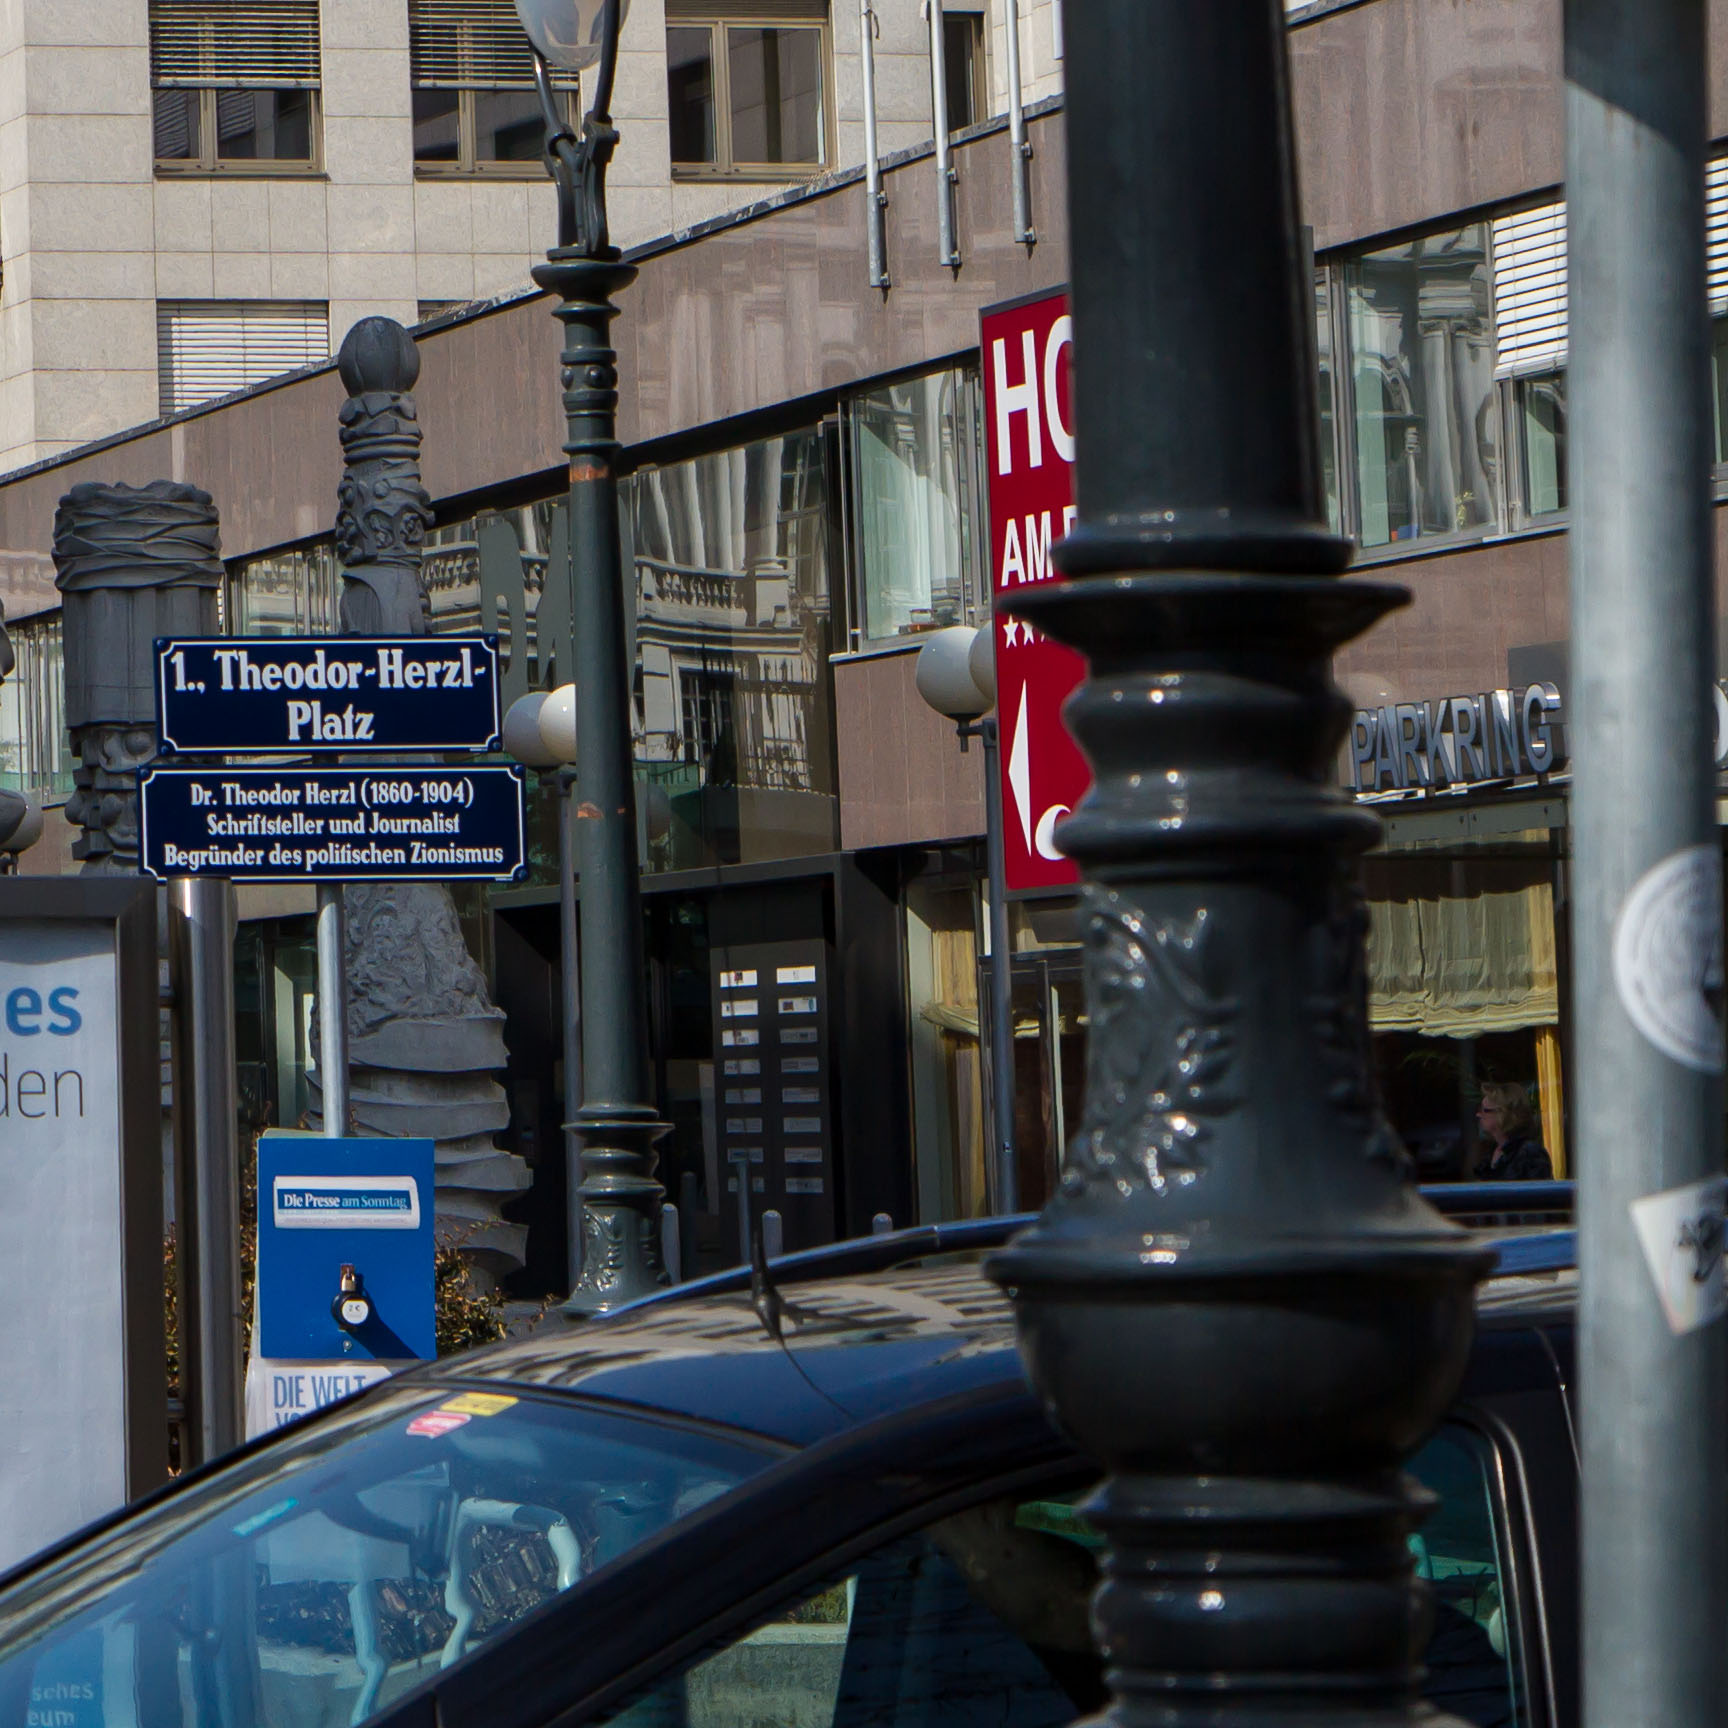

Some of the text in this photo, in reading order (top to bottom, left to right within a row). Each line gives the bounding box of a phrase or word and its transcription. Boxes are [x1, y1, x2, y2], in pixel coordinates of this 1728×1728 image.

[1001, 511, 1054, 587] AM
[214, 649, 486, 690] Theodor-Herzl-
[287, 701, 375, 740] Platz
[1351, 682, 1562, 792] PARKRING
[190, 777, 474, 809] Dr. Theodor Herzl (1860-1904)
[207, 811, 460, 836] Schriftsteller und Journalist
[164, 842, 504, 872] Begründer des politischen Zionismus
[284, 1192, 408, 1210] Die Presse am Sonntag
[273, 1375, 306, 1408] DIE
